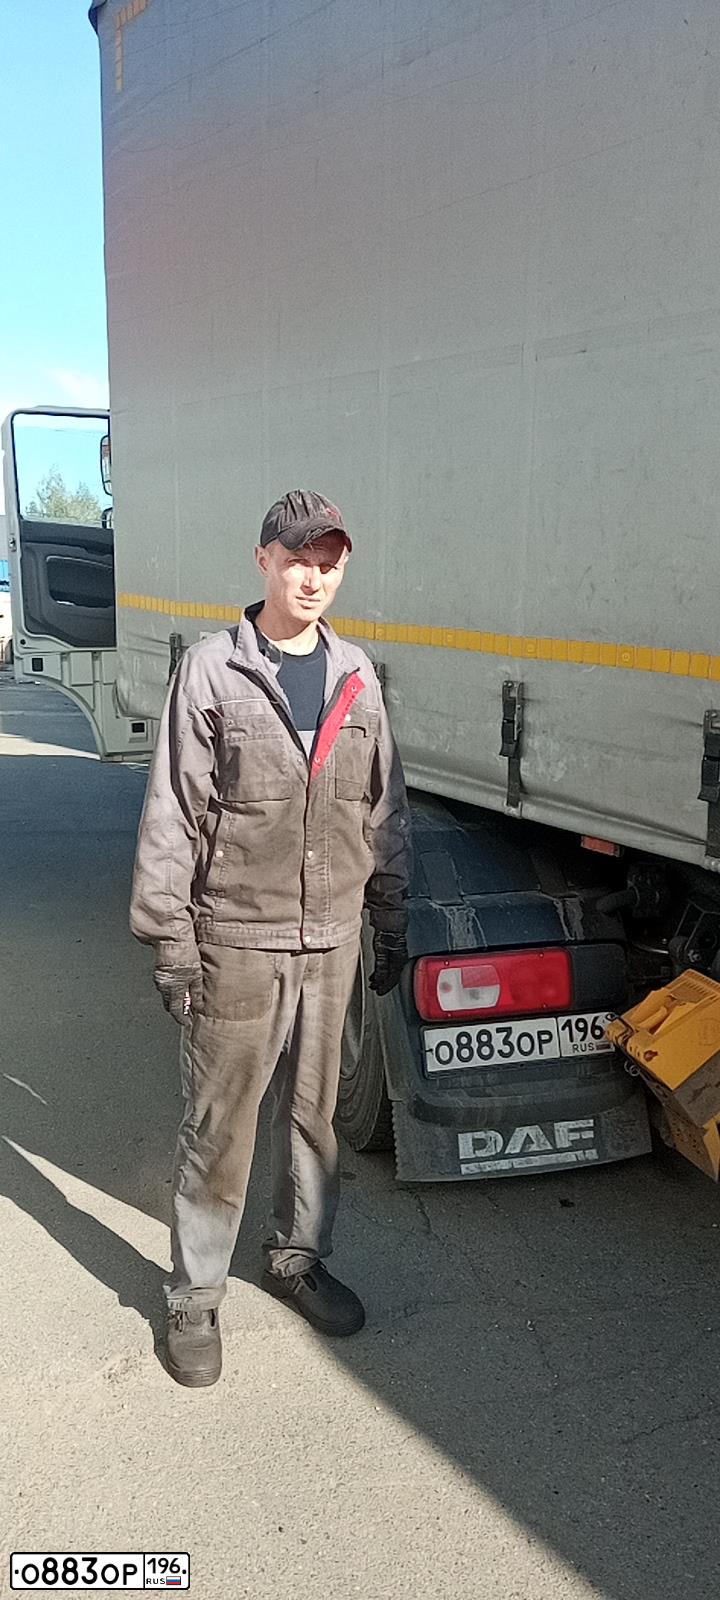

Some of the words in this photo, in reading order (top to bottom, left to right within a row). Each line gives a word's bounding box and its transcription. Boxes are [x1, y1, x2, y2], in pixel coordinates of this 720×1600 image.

[561, 1016, 604, 1044] 196
[572, 1042, 595, 1053] RUS
[457, 1119, 594, 1159] DAF
